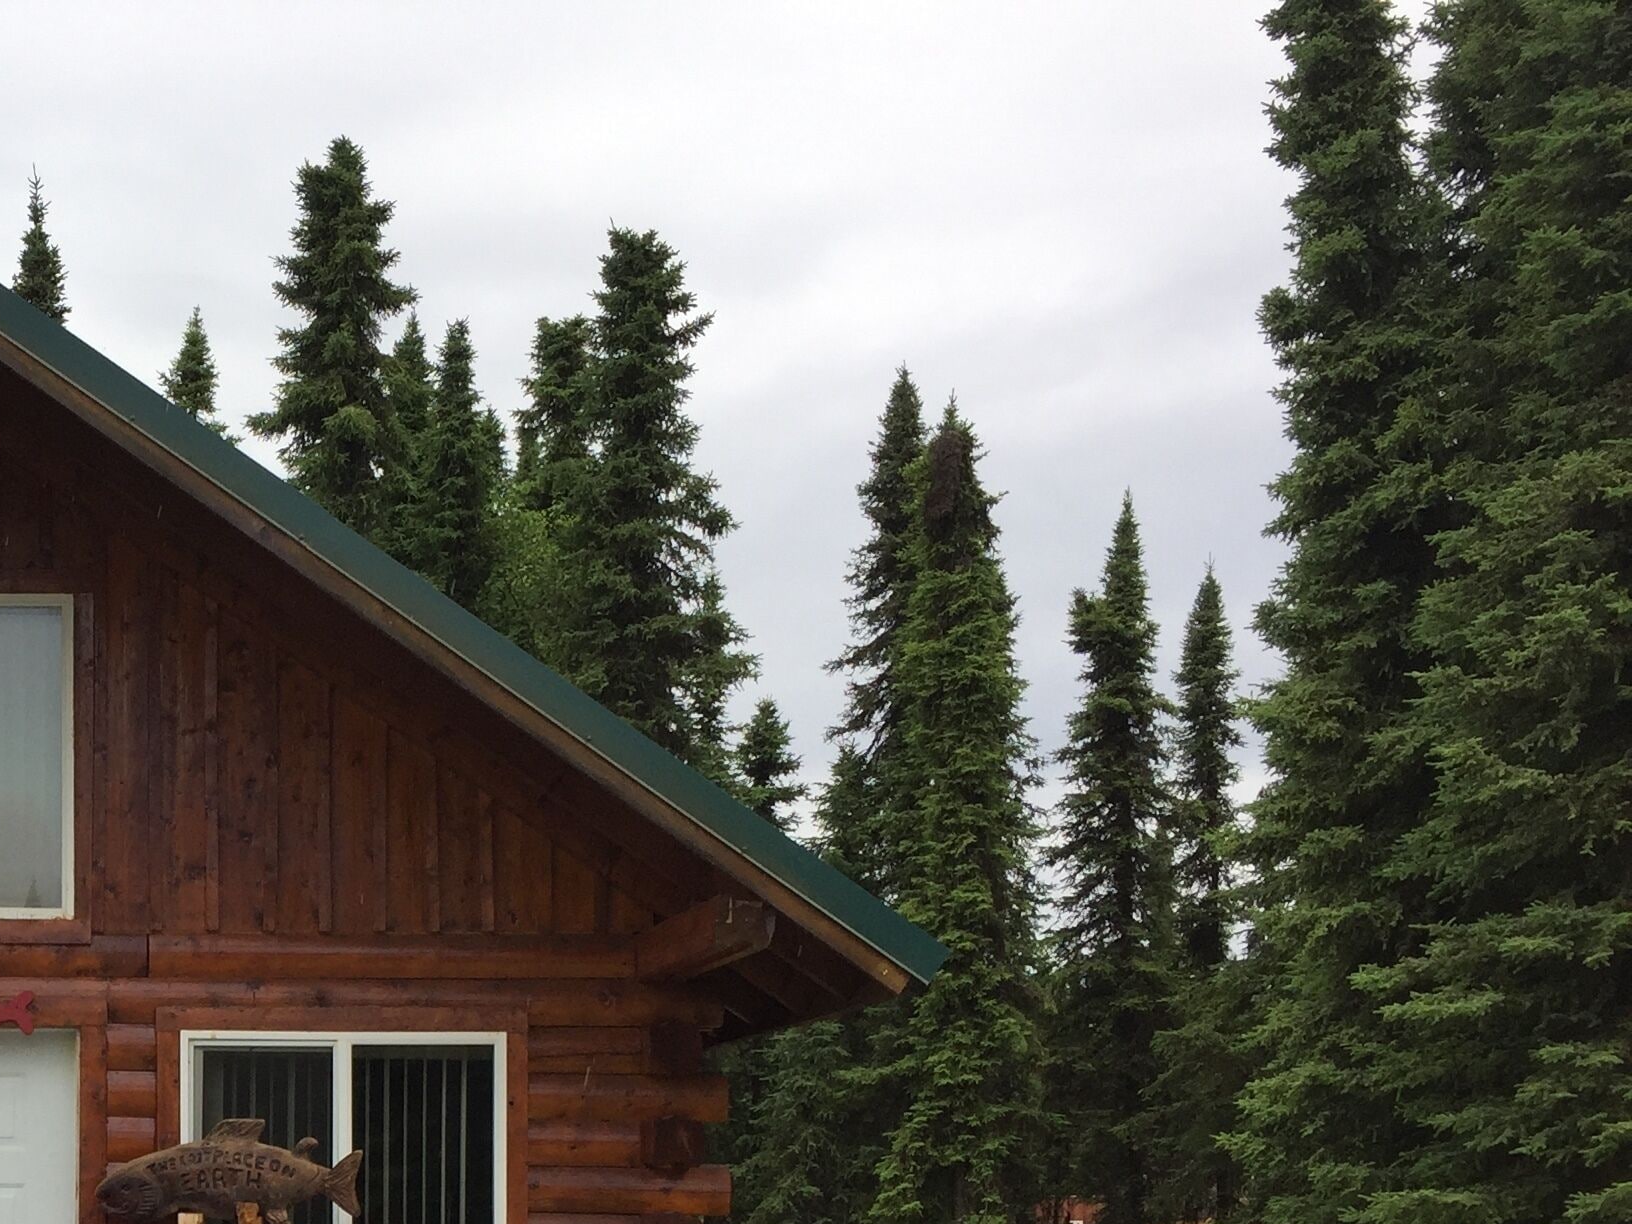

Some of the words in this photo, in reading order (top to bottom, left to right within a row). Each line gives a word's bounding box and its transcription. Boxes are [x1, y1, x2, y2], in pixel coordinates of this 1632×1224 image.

[145, 1156, 177, 1174] THE
[212, 1149, 267, 1171] PLACE
[269, 1158, 297, 1179] ON
[179, 1167, 263, 1191] EARTH
